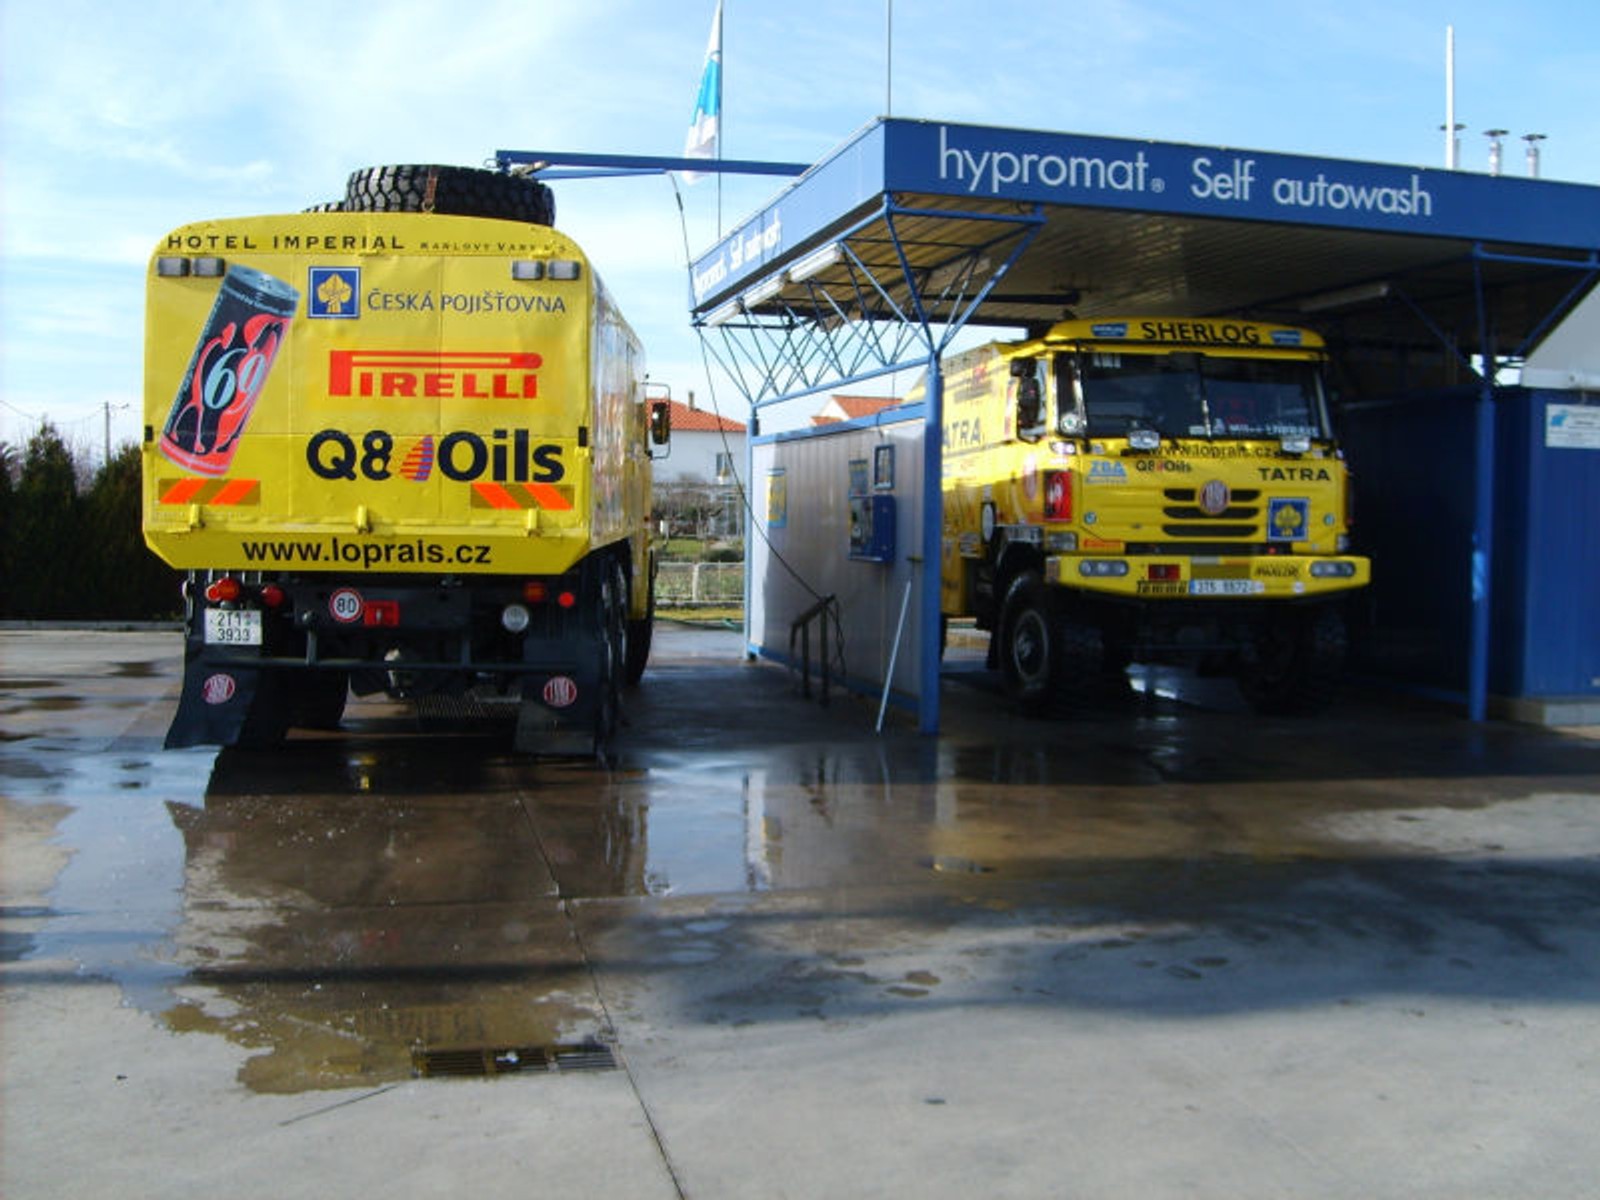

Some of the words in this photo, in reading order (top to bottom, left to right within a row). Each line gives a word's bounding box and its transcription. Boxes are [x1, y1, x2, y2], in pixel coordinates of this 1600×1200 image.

[1190, 157, 1256, 201] Self
[1272, 174, 1432, 217] autowash
[167, 235, 258, 250] HOTEL
[273, 235, 405, 250] IMPERIAL
[367, 288, 435, 312] ČESKÁ
[1140, 321, 1261, 344] SHERLOG
[328, 349, 544, 399] PIRELLI
[306, 428, 394, 482] Q8
[437, 428, 566, 483] Oils
[1258, 467, 1331, 482] TATRA
[241, 536, 493, 569] www.loprais.cz
